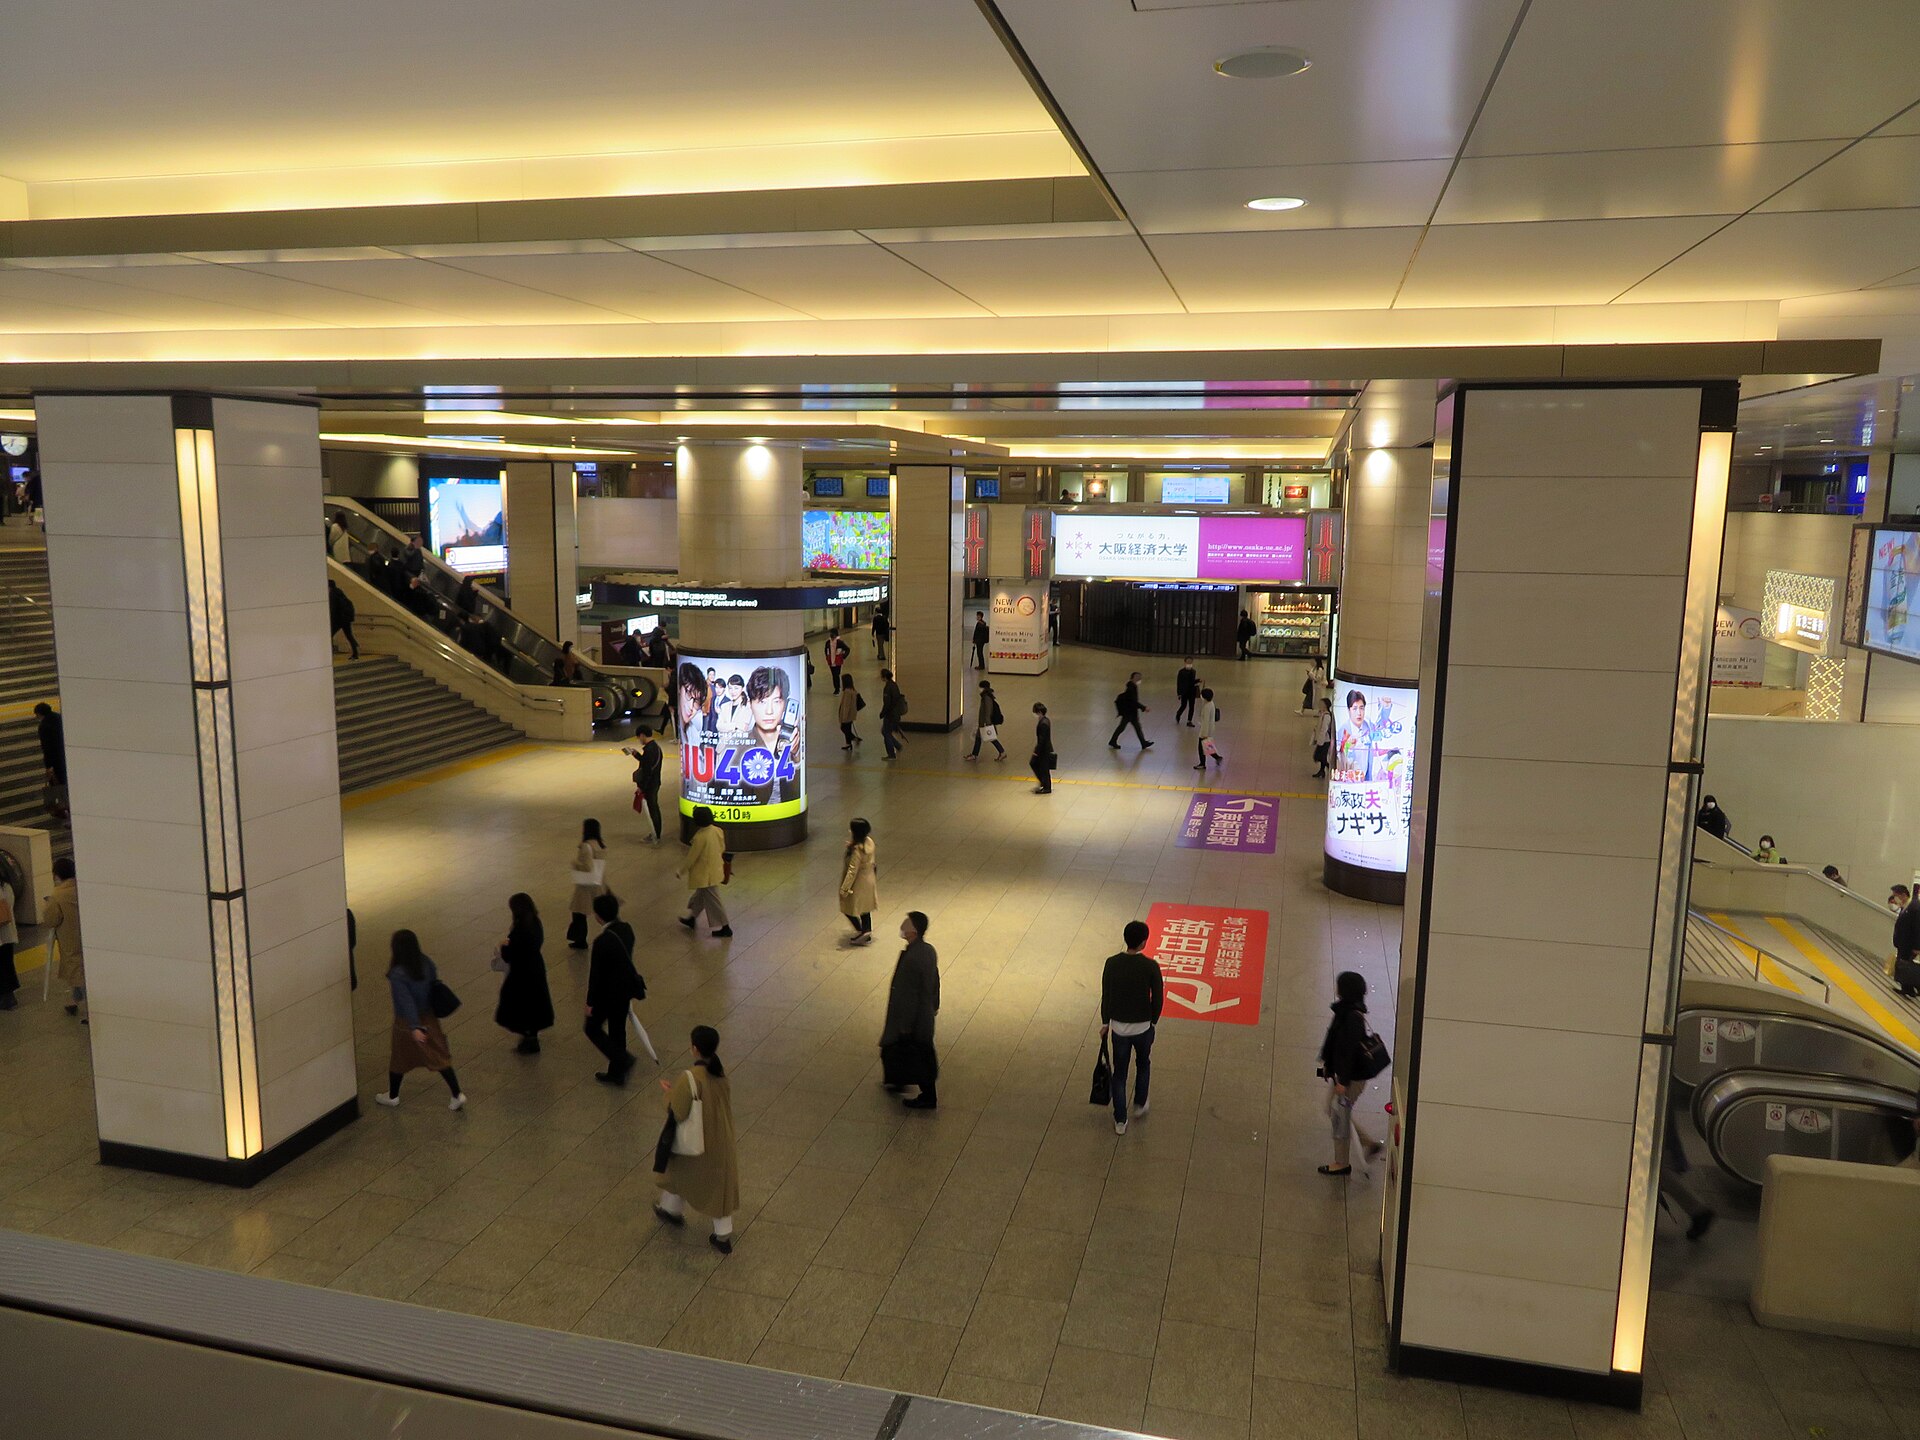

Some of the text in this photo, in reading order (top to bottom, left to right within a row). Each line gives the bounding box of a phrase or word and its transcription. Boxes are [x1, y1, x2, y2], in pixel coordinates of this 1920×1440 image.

[1098, 543, 1188, 556] 大阪経済大学
[712, 599, 736, 607] Central
[995, 598, 1013, 606] NEW
[993, 606, 1015, 614] OPEN!
[1206, 812, 1243, 846] 東梅田駅
[1153, 918, 1215, 975] 梅田駅
[1213, 916, 1249, 978] 地下鉄御堂筋線
